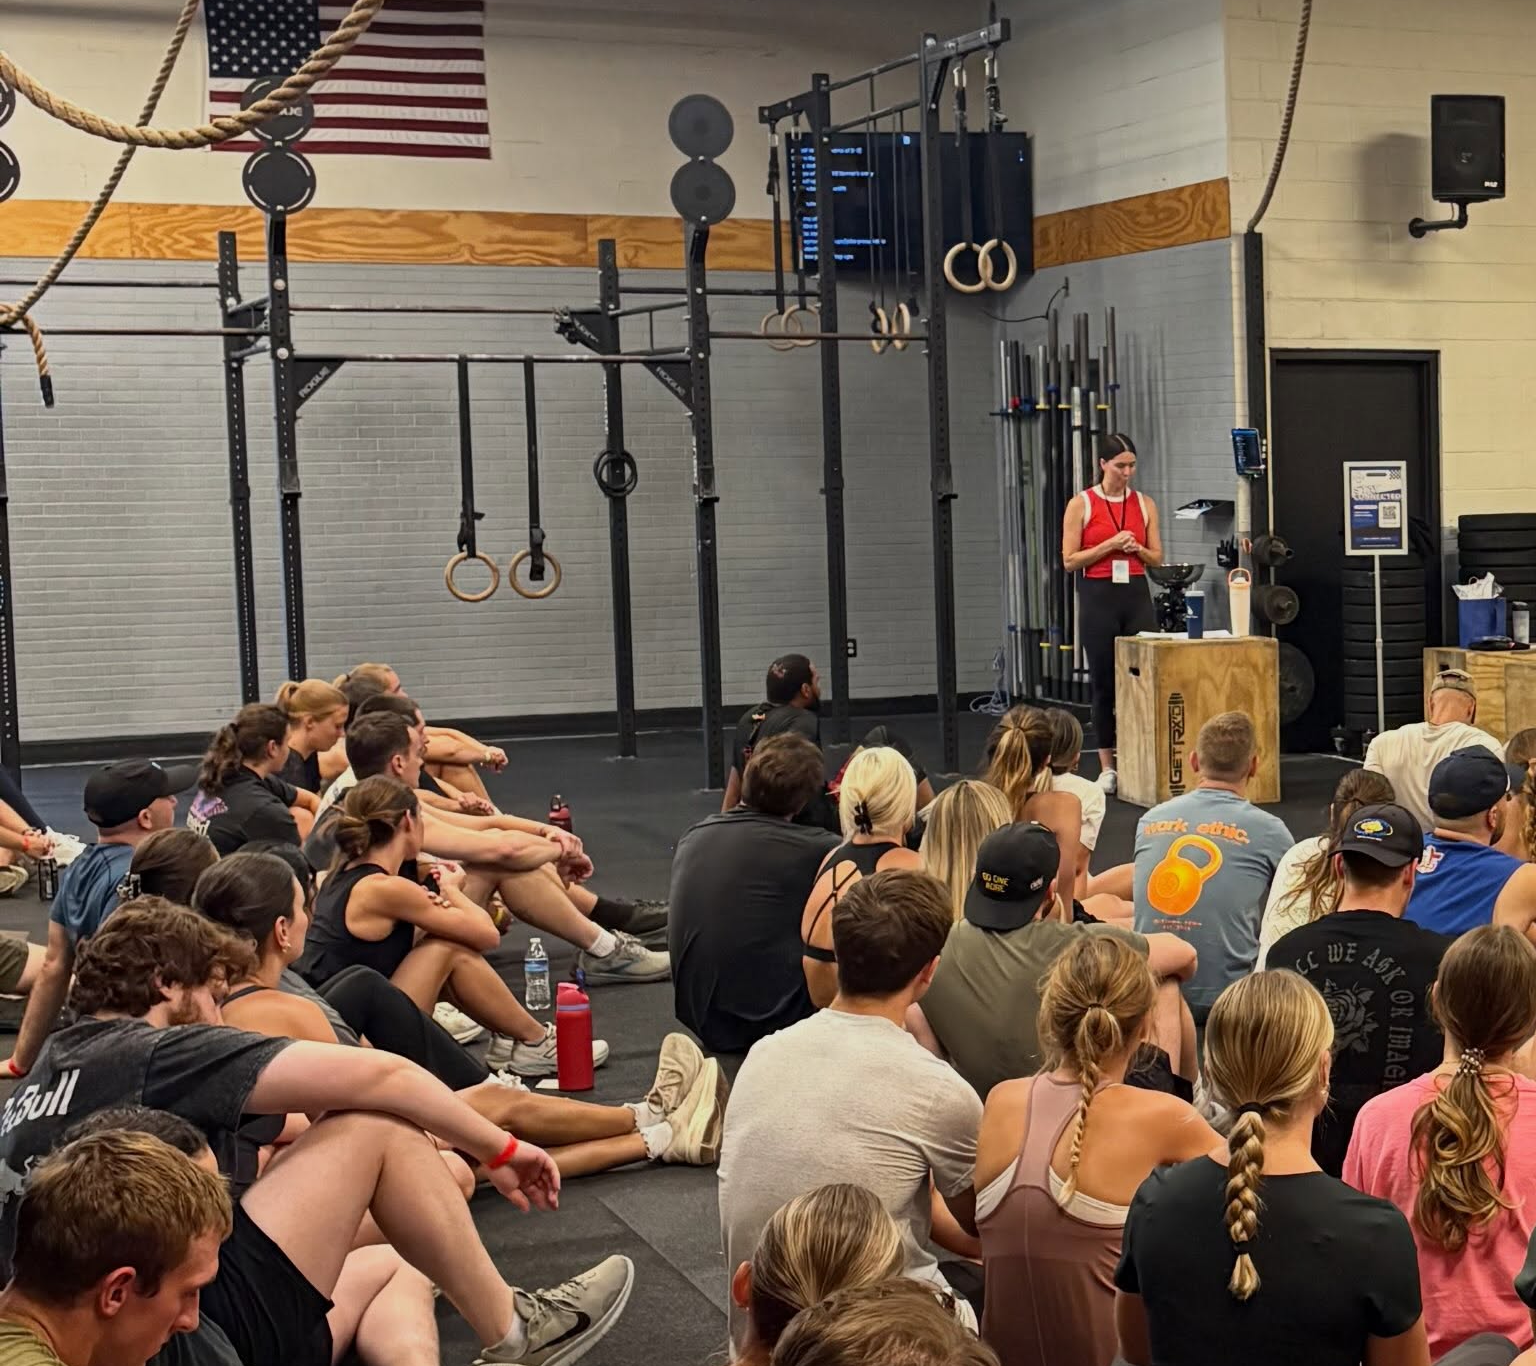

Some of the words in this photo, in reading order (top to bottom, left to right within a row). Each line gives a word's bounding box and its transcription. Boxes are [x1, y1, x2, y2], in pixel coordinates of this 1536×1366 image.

[1296, 950, 1319, 975] LL
[1327, 942, 1358, 963] WE
[1361, 947, 1406, 985] ASK
